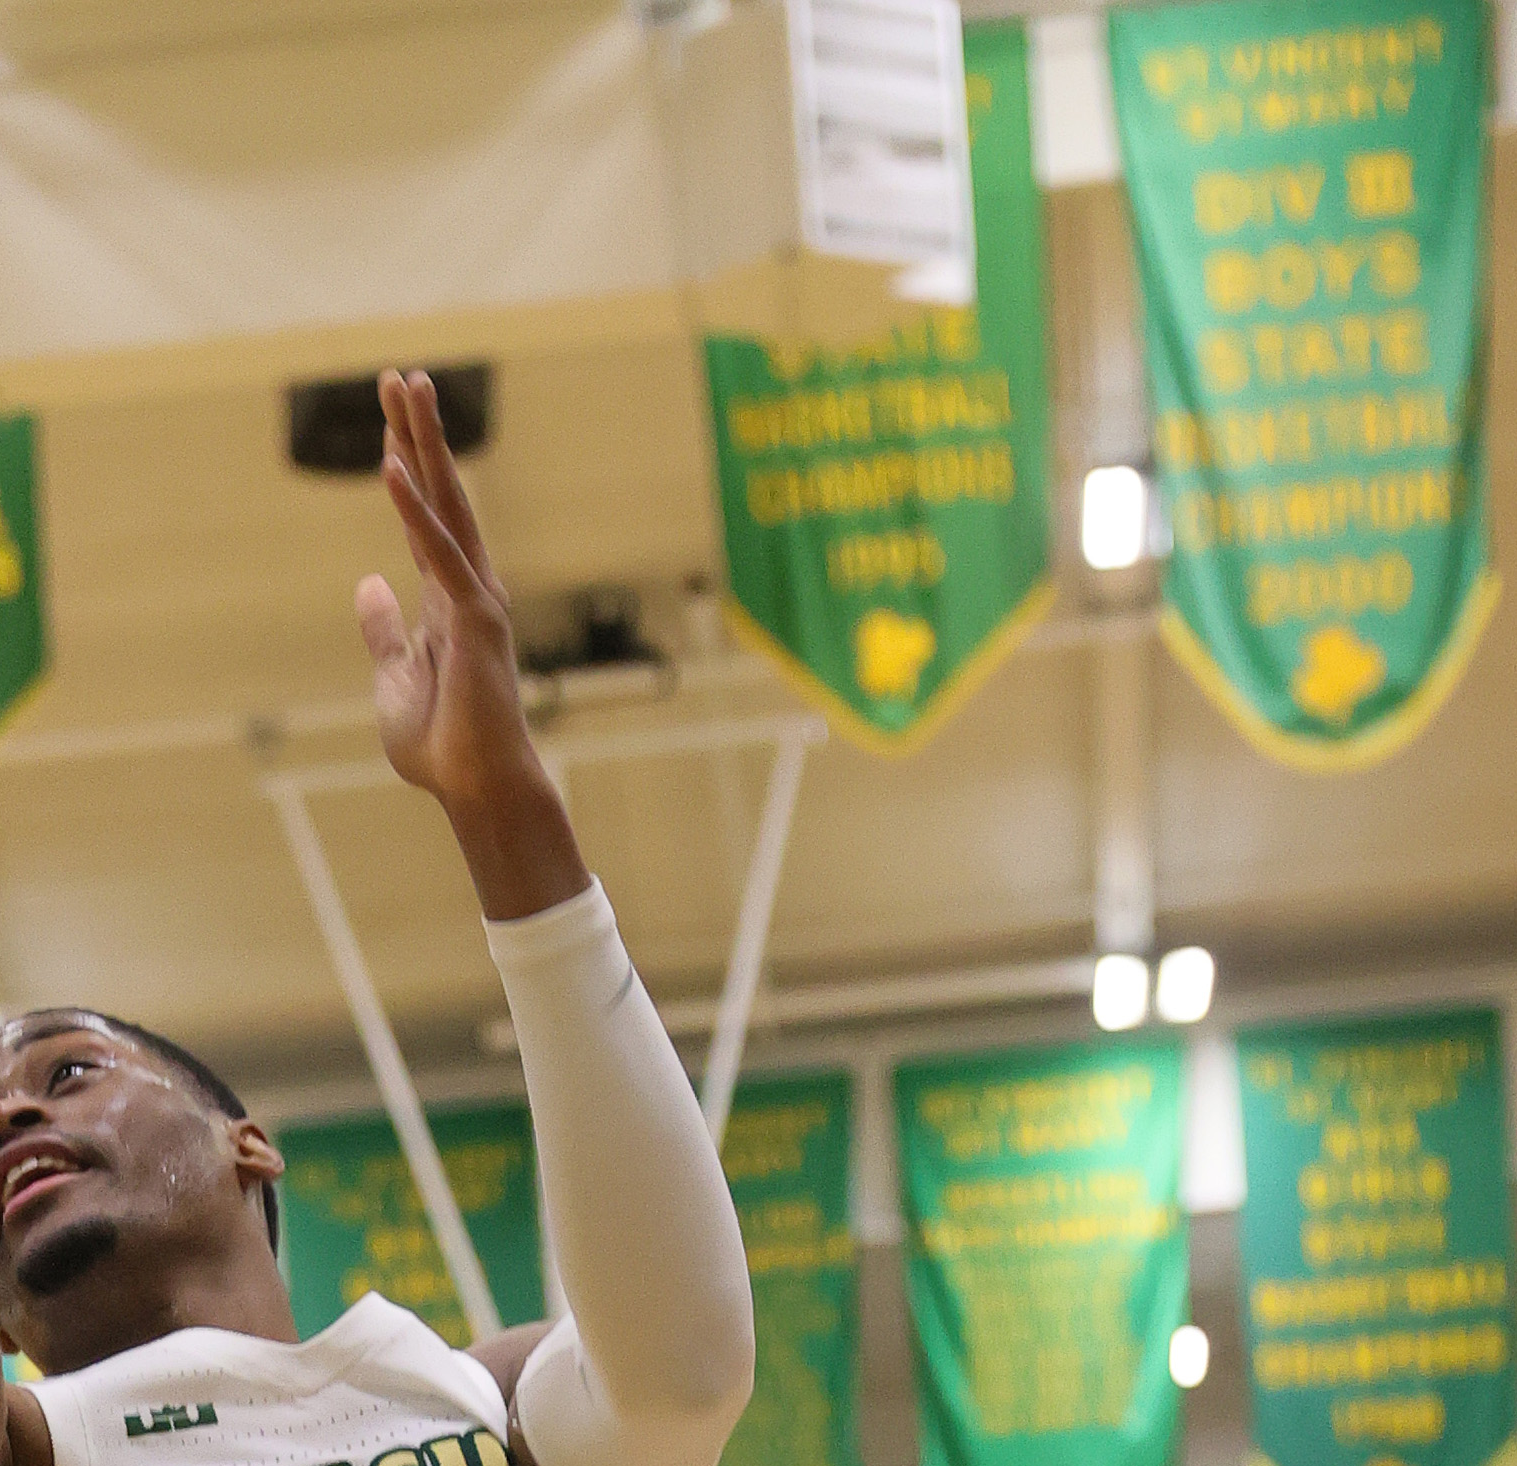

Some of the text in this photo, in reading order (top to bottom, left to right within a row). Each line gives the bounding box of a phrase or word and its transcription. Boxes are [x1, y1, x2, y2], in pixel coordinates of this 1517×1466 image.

[1198, 166, 1322, 235] DIV
[1207, 233, 1417, 313] BOYS
[1201, 311, 1428, 392] STATE
